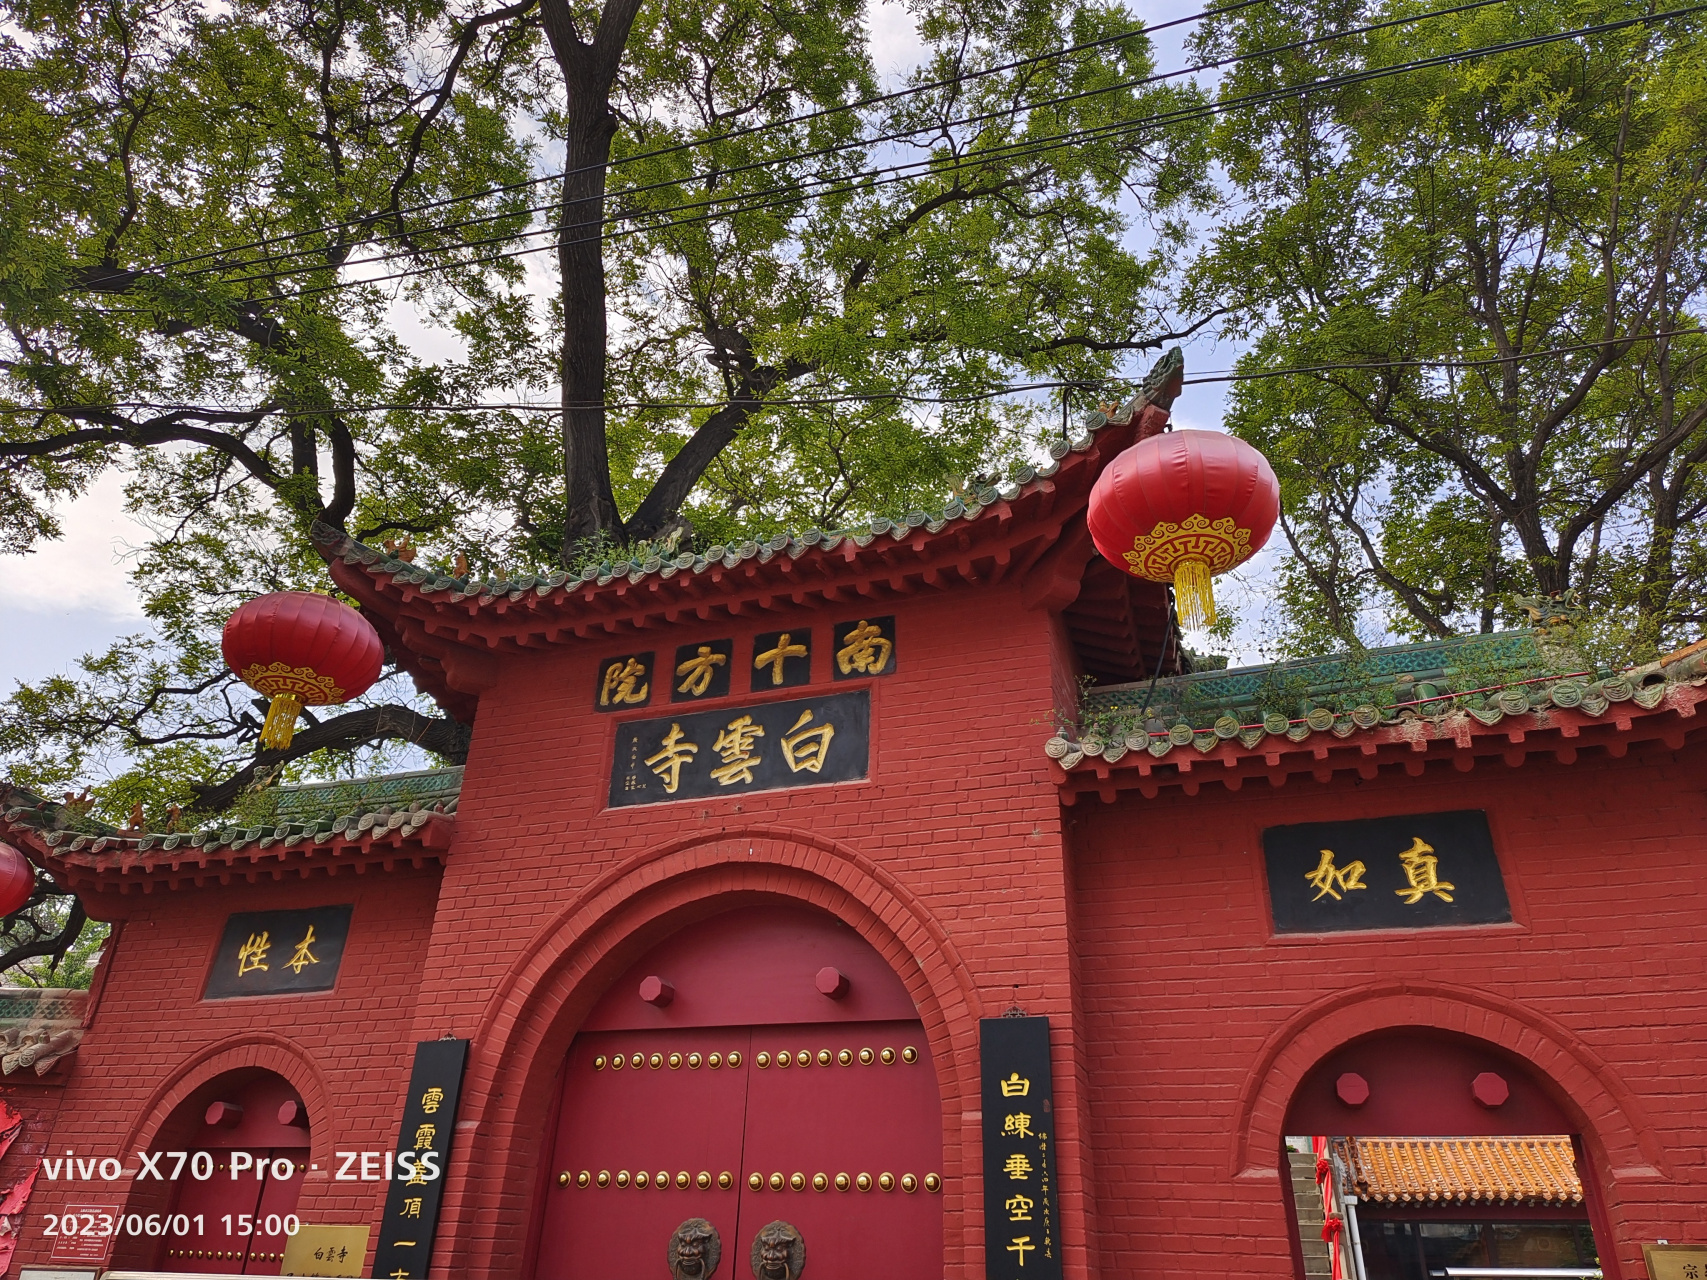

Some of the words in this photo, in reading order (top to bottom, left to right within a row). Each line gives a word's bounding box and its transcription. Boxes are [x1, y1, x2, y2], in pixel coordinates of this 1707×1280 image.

[644, 709, 835, 794] 白雲寺
[313, 1245, 348, 1264] 白雲寺
